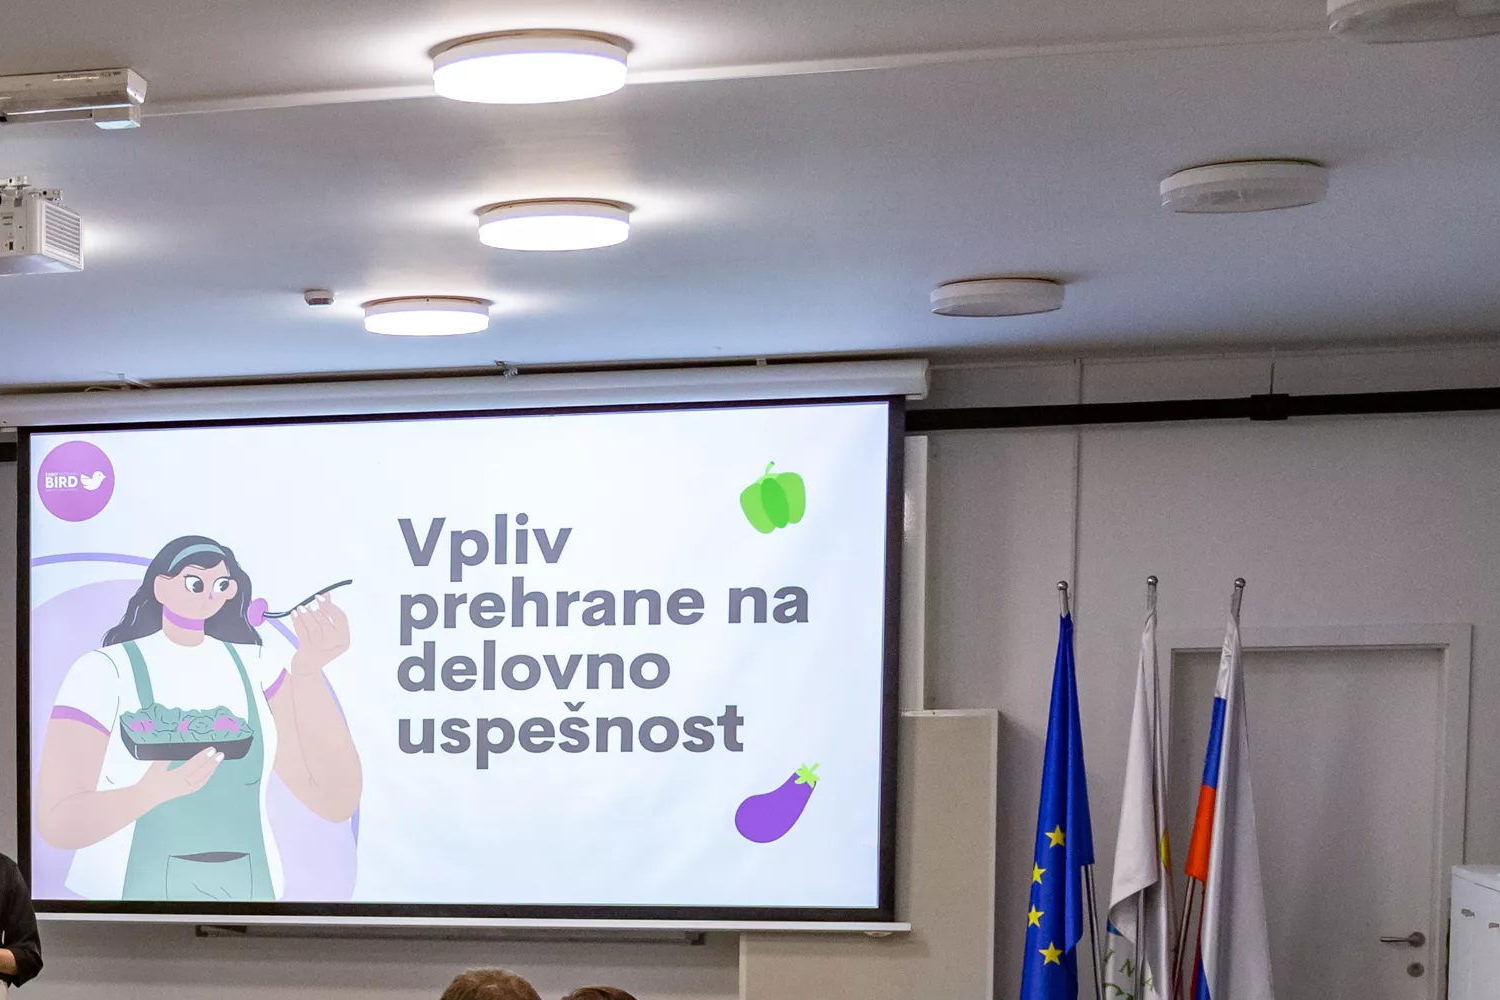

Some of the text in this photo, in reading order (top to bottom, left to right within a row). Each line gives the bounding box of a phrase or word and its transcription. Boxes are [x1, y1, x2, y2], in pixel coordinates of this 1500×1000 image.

[45, 475, 78, 489] BIRD
[397, 512, 573, 582] Vpliv
[400, 576, 809, 646] prehrane na
[397, 640, 670, 692] delovno
[398, 702, 744, 770] uspešnost
